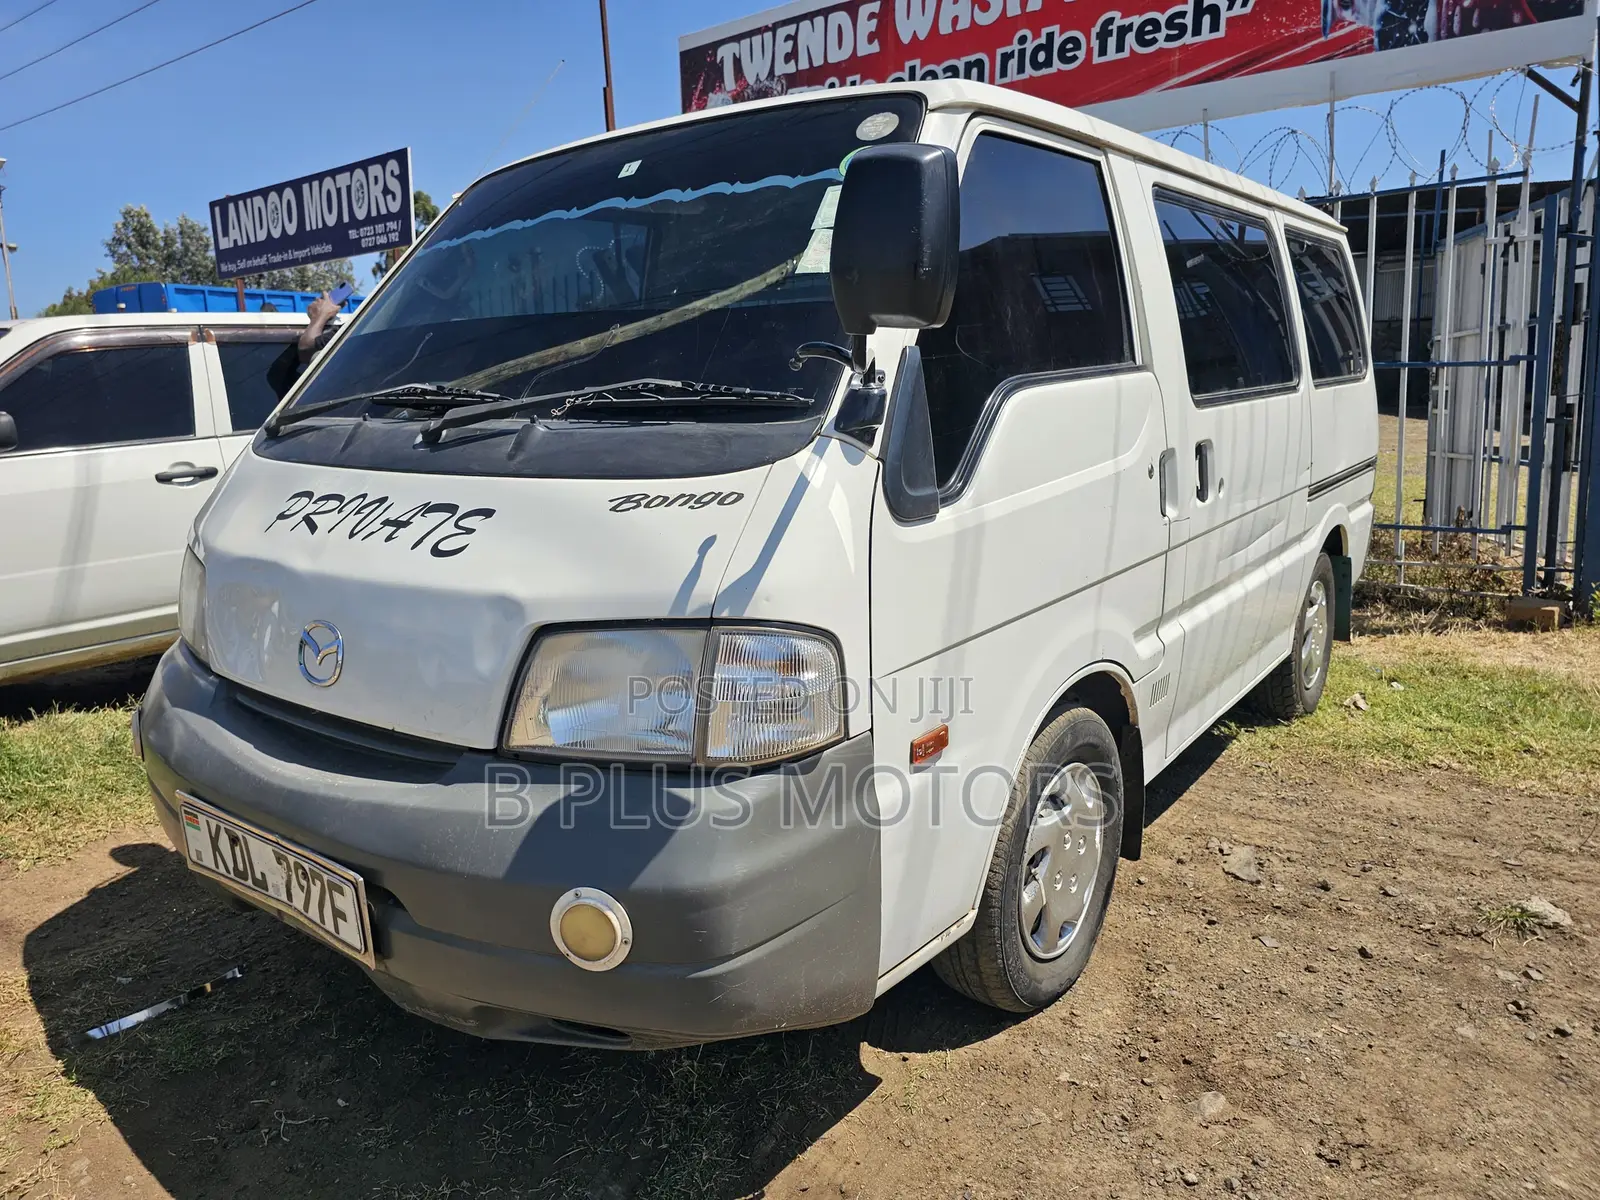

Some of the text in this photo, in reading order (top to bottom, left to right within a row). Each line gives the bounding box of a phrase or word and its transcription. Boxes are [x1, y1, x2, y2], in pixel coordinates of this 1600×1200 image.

[716, 1, 881, 92] TWENDE
[998, 28, 1084, 81] ride
[214, 159, 402, 250] LANDOO MOTORS
[311, 242, 332, 256] Vehicles
[264, 490, 497, 558] PRIVATE
[608, 491, 745, 513] Bongo
[206, 819, 348, 935] KDL 797F
